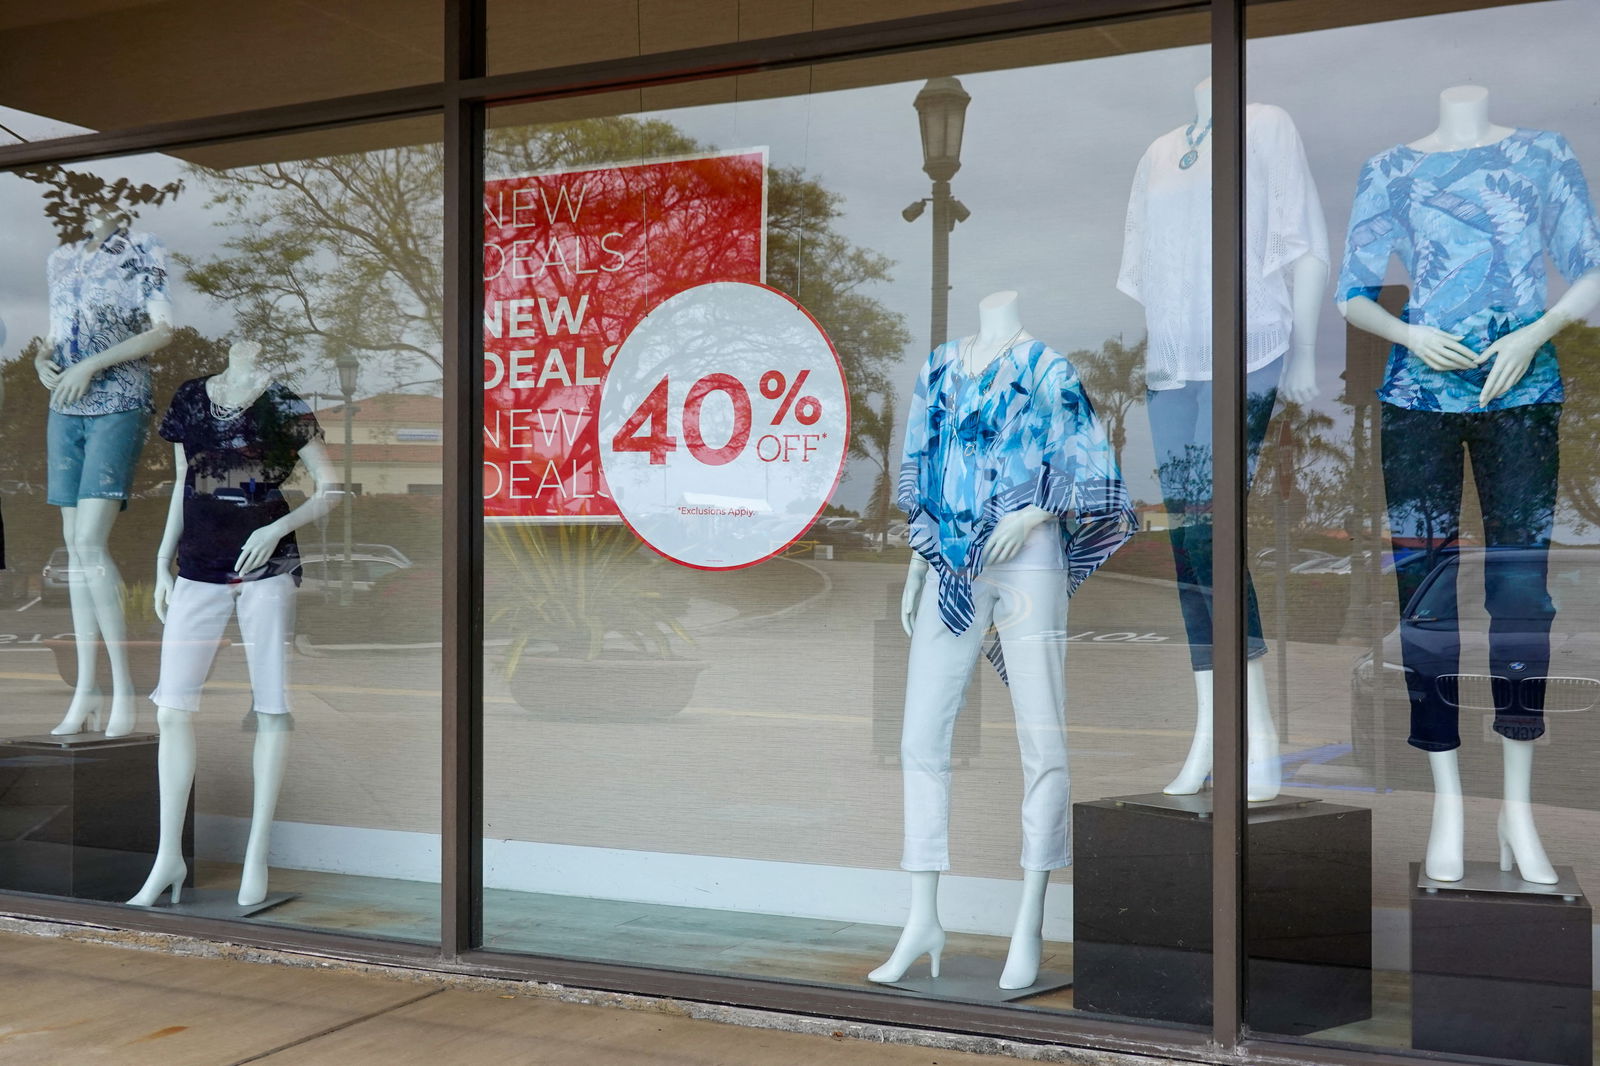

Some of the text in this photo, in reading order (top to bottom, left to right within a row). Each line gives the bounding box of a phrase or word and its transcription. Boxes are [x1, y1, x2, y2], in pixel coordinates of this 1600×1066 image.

[484, 184, 587, 229] NEW
[484, 232, 625, 280] DEALS
[484, 295, 590, 339] NEW
[484, 407, 585, 449] NEW
[612, 369, 823, 466] 40%
